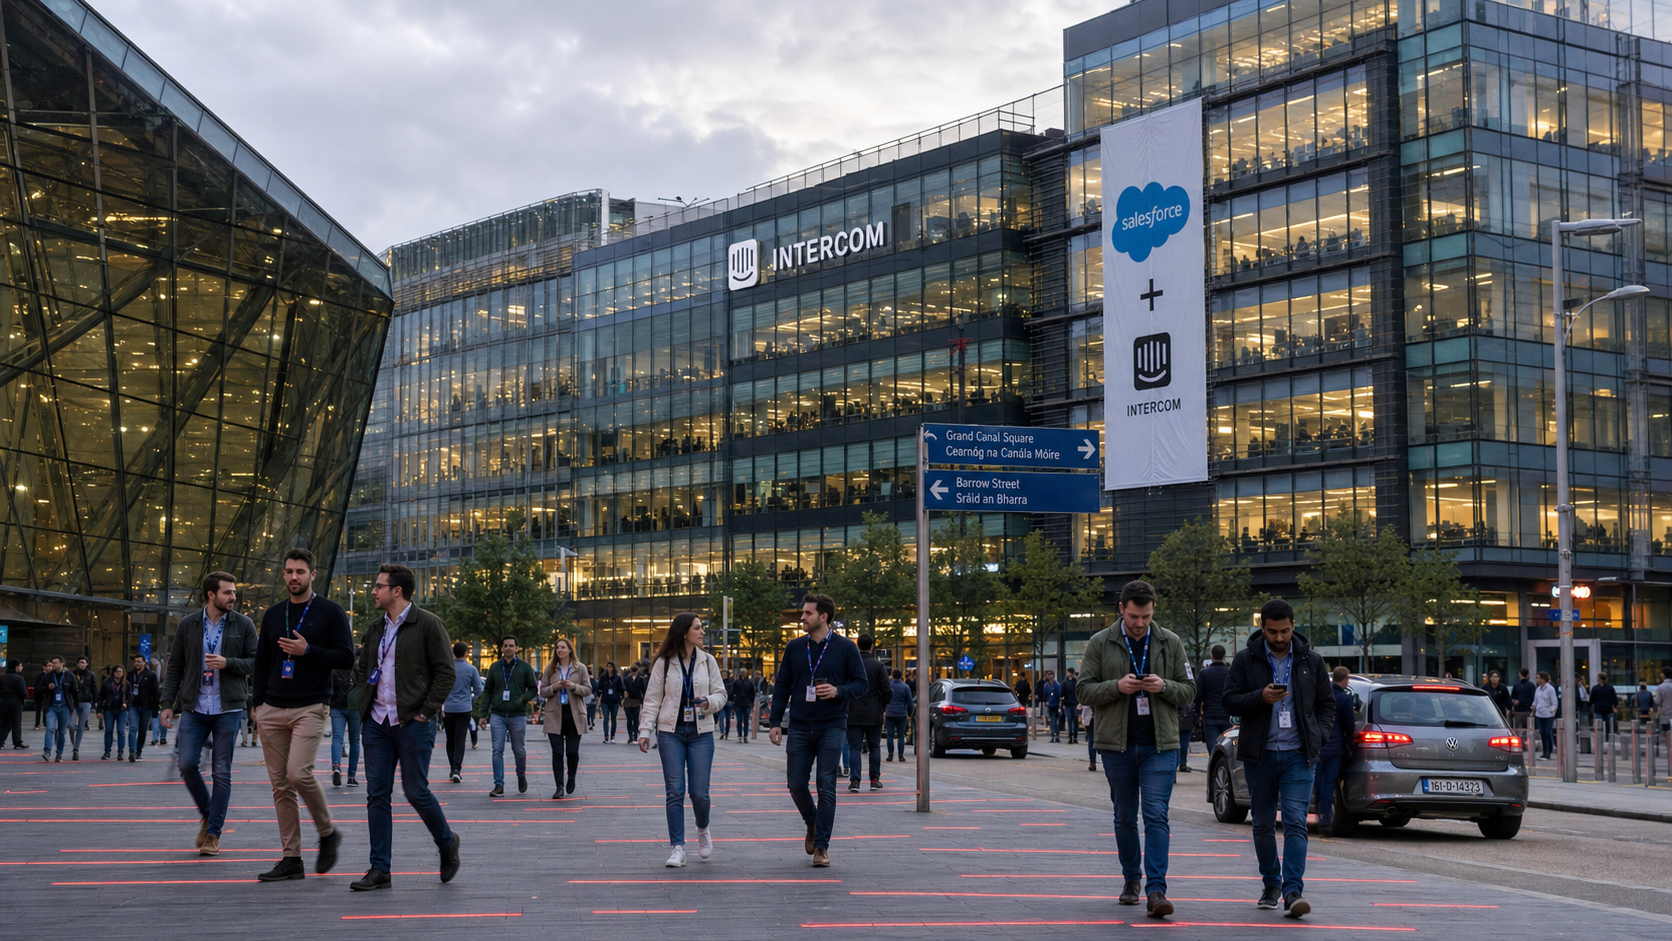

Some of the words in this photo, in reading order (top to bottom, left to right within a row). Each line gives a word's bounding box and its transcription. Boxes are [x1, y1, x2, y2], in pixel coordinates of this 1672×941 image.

[1122, 205, 1183, 231] salesforce
[773, 221, 884, 271] INTERCOM
[1127, 398, 1182, 417] INTERCOM
[946, 430, 973, 442] Grand
[976, 431, 1000, 442] Canal
[1003, 433, 1034, 446] Square
[945, 446, 984, 460] Cearnóg
[987, 449, 998, 458] na
[1001, 448, 1032, 459] Canála
[1035, 449, 1060, 460] Móire
[956, 477, 989, 489] Barrow
[992, 478, 1020, 490] Street
[956, 492, 980, 504] Sráid
[982, 496, 994, 504] an
[997, 494, 1027, 505] Bharra
